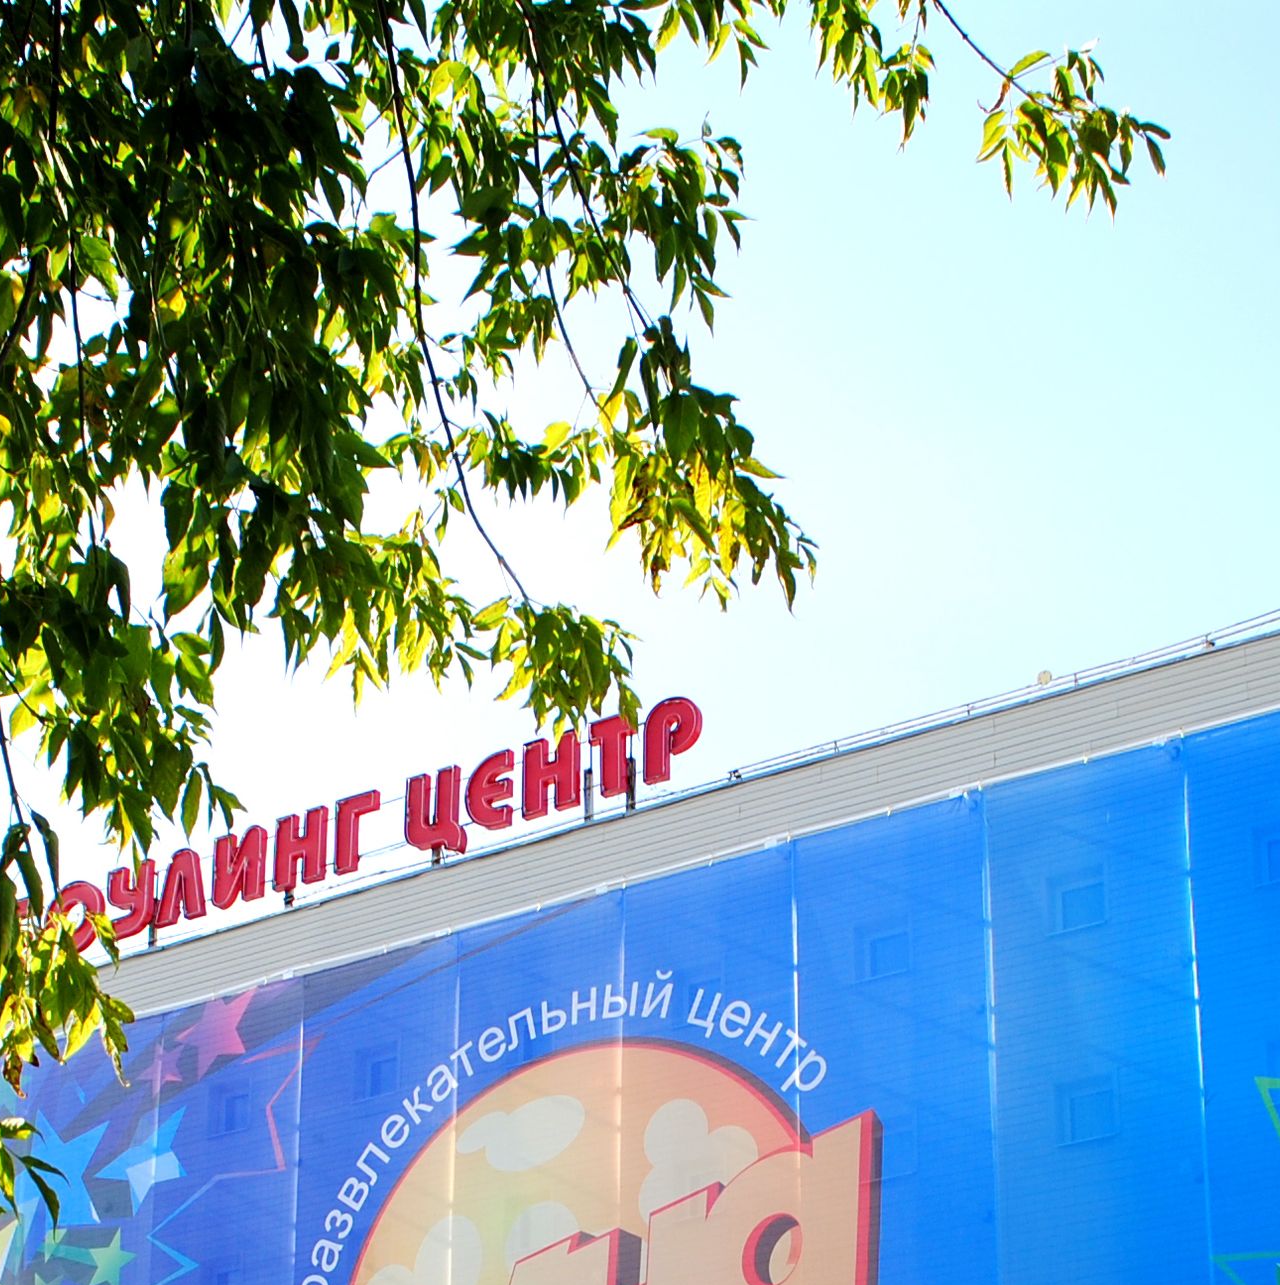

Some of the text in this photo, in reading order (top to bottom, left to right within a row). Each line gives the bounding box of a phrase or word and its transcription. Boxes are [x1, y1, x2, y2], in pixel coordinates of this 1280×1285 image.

[11, 788, 381, 953] ОУЛИНГ
[404, 696, 703, 854] ЦЕНТР
[688, 986, 827, 1095] центр
